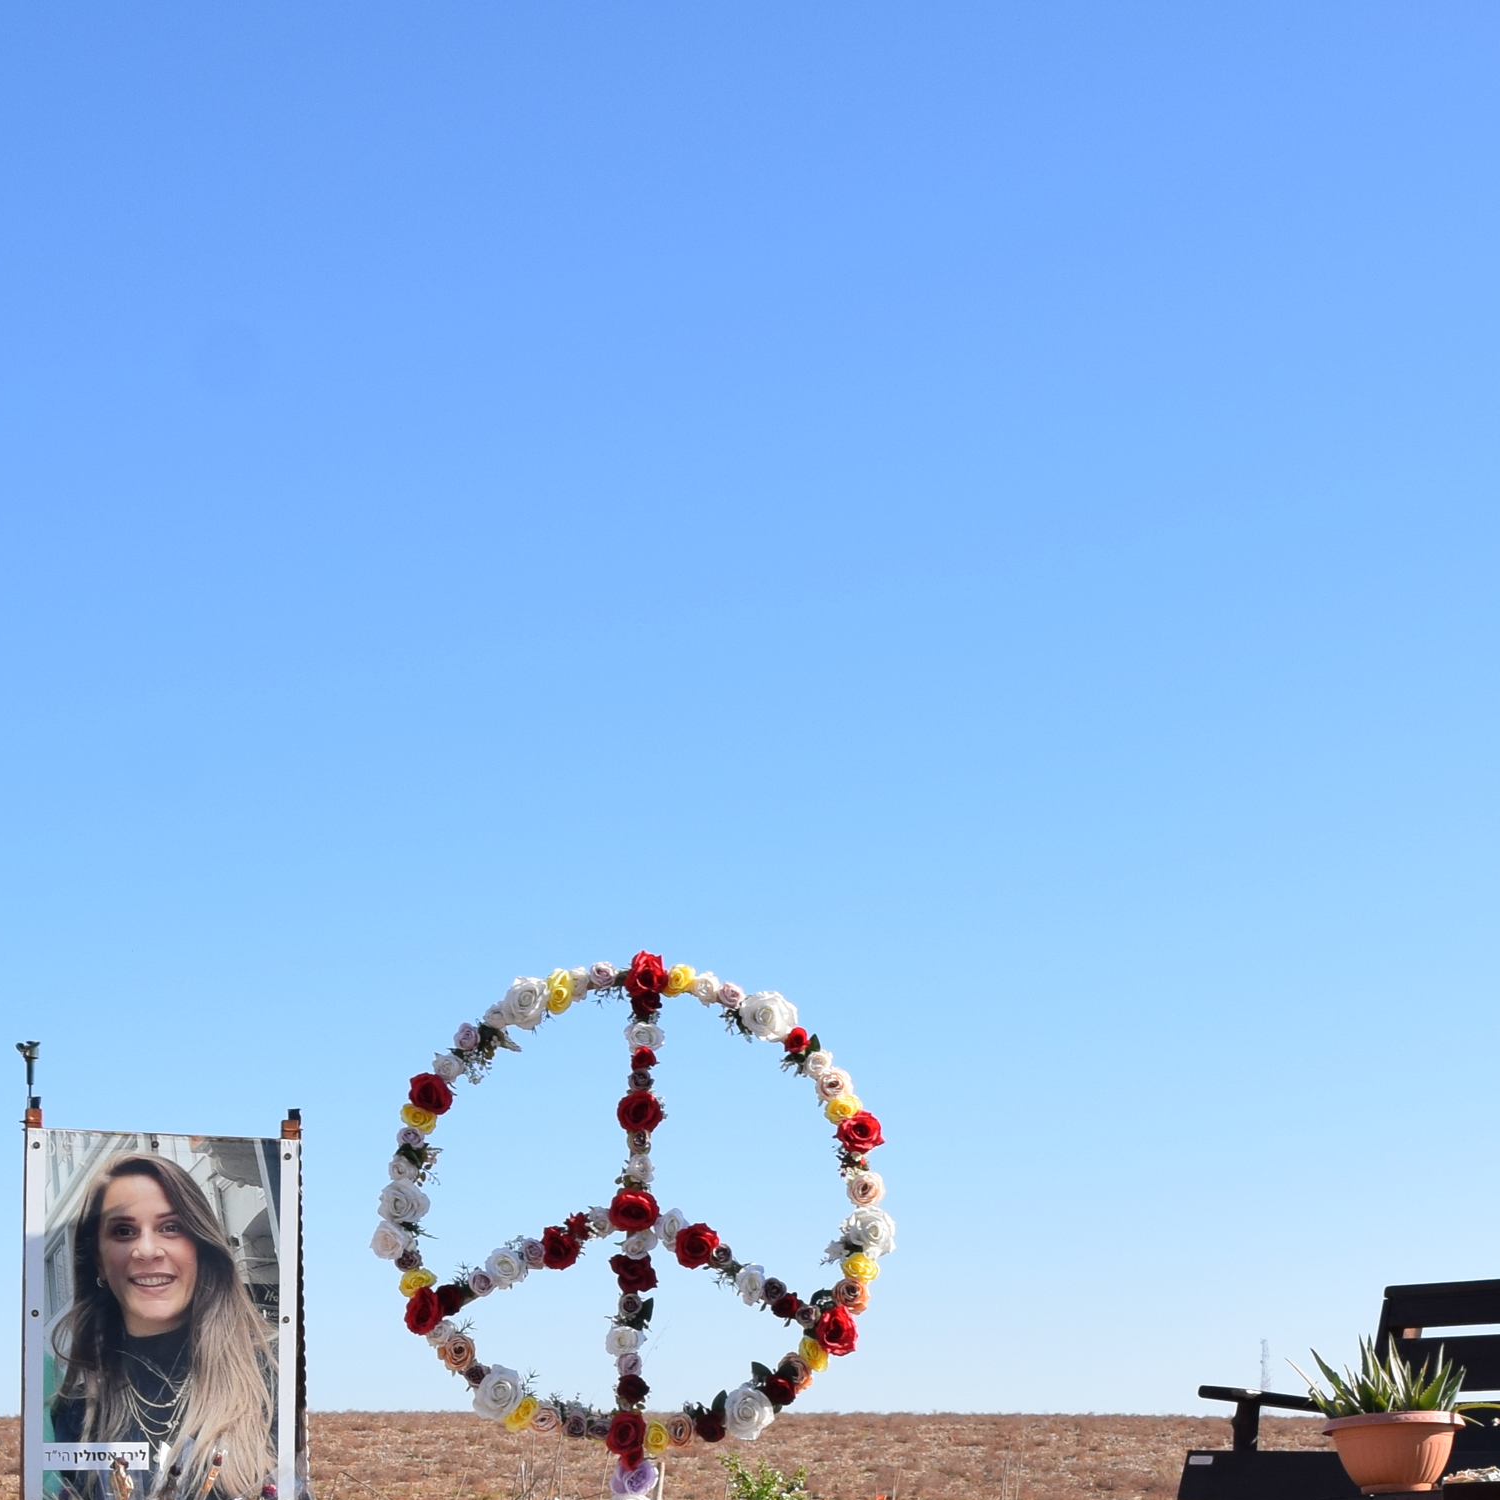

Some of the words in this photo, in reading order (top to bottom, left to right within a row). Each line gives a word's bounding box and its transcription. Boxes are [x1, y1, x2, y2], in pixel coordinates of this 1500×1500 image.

[45, 1449, 70, 1462] הי"ד
[73, 1449, 118, 1464] אסולין
[121, 1449, 147, 1462] לירז
